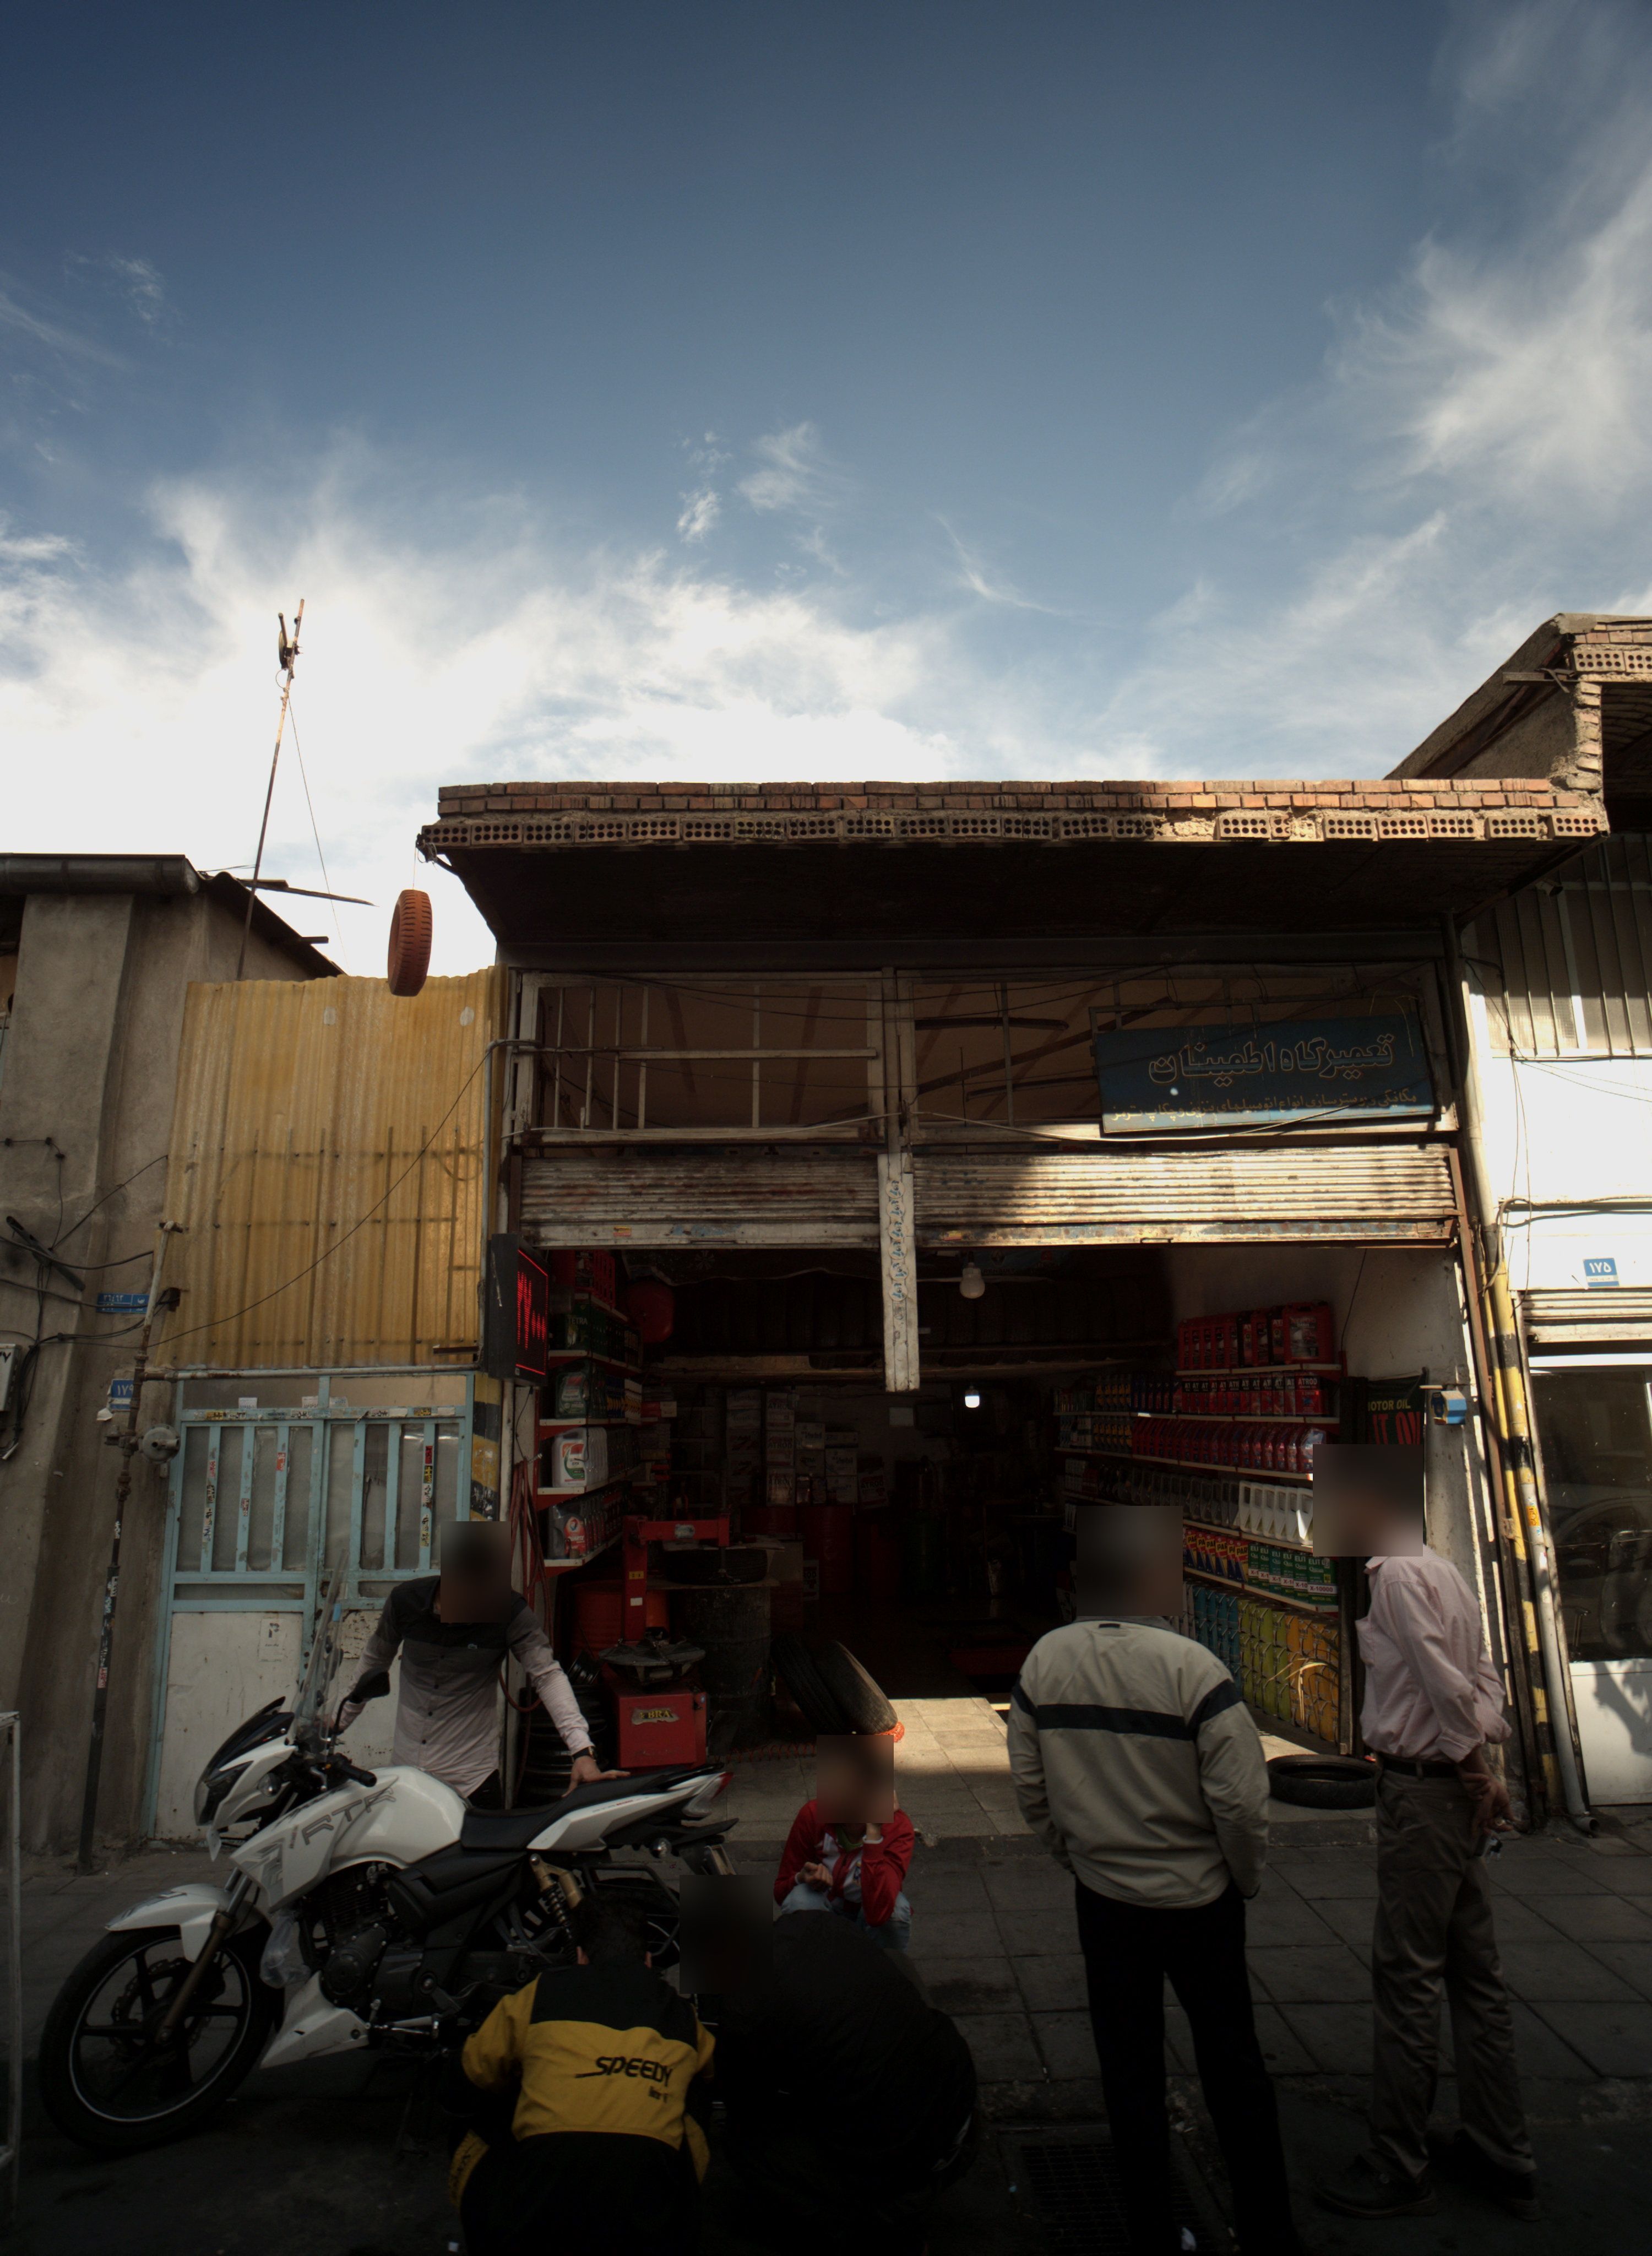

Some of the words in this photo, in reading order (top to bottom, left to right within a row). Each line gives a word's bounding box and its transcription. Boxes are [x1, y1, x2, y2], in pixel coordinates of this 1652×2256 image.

[1149, 1040, 1276, 1087] اطمینان
[1280, 1033, 1395, 1080] تعمیرگاه
[1589, 1261, 1612, 1273] ۱۷۵
[1396, 1399, 1411, 1410] OIL
[639, 1710, 673, 1718] BRA
[302, 1787, 396, 1846] RTR
[575, 2056, 673, 2086] SPEEDY
